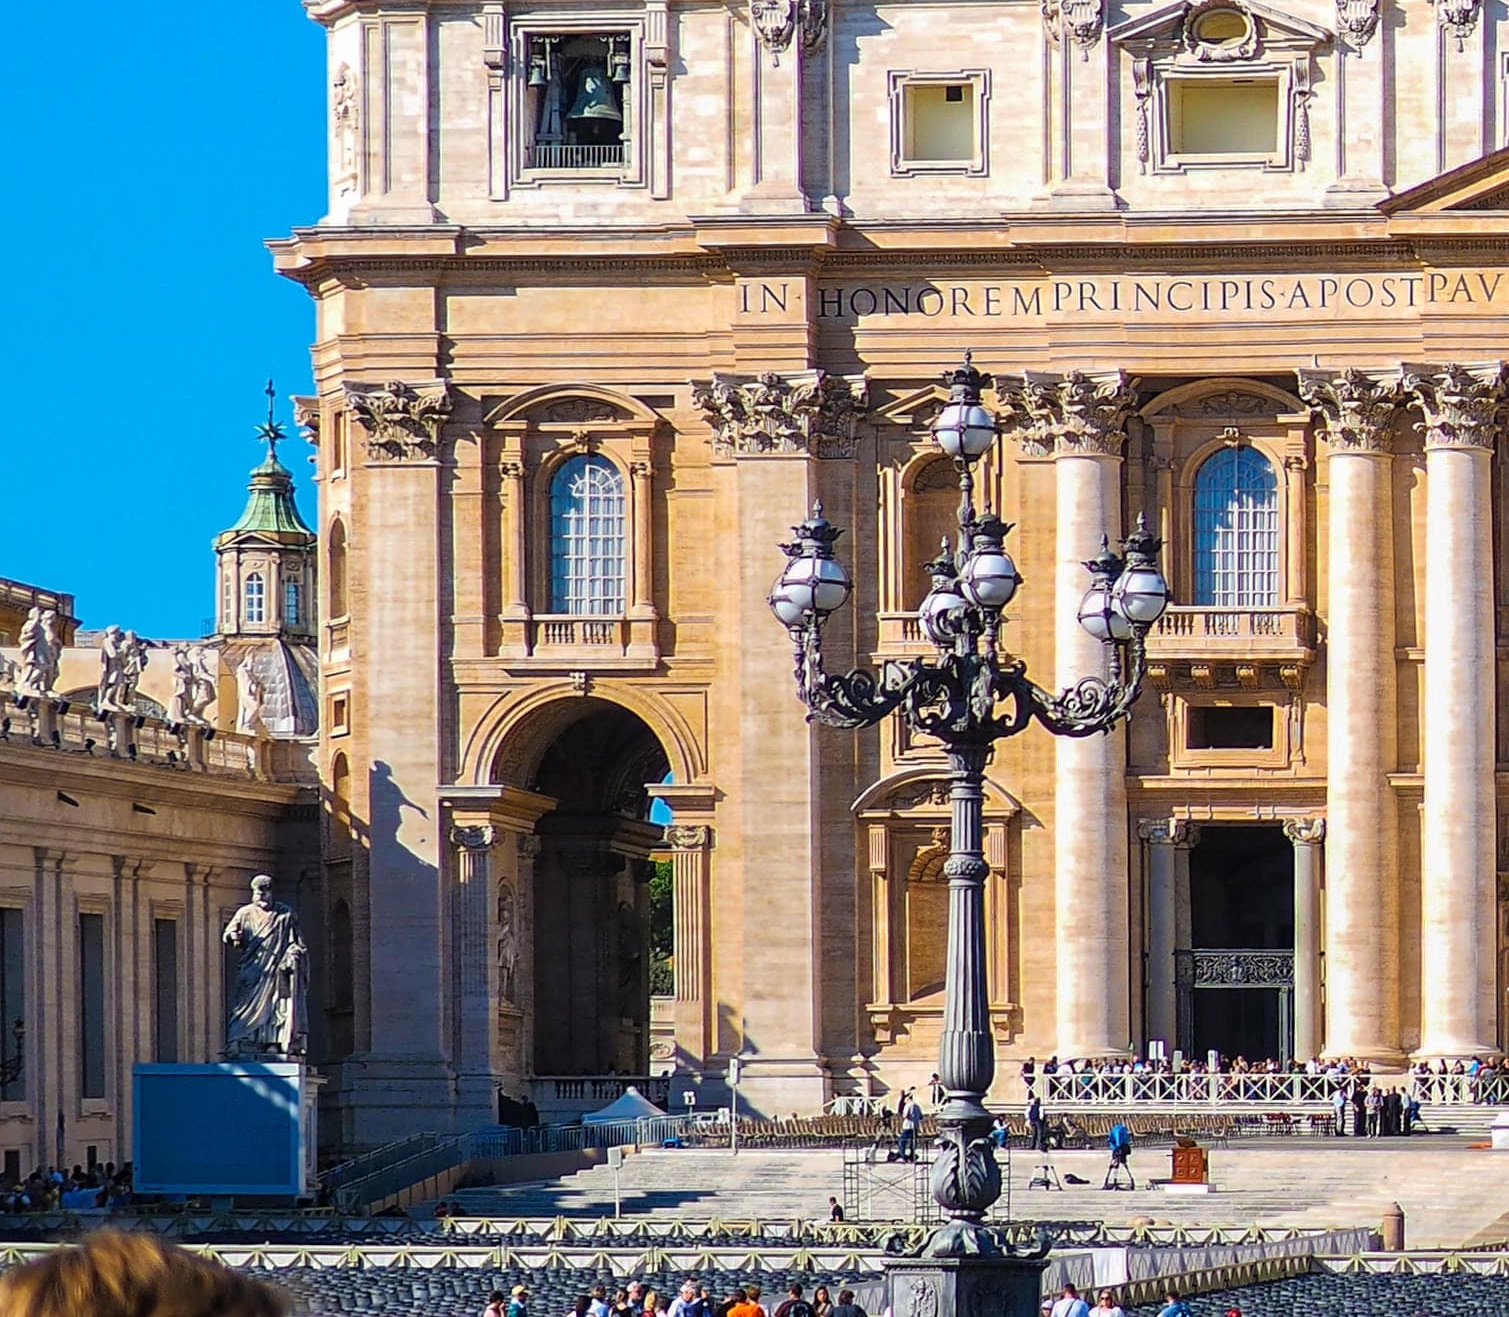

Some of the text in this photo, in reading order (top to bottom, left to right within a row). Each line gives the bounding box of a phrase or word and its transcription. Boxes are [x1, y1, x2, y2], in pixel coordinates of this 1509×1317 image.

[738, 283, 790, 313] IN
[817, 285, 1044, 317] HONOREM
[1053, 279, 1276, 312] PRINCIPIS
[1287, 276, 1423, 309] APOST
